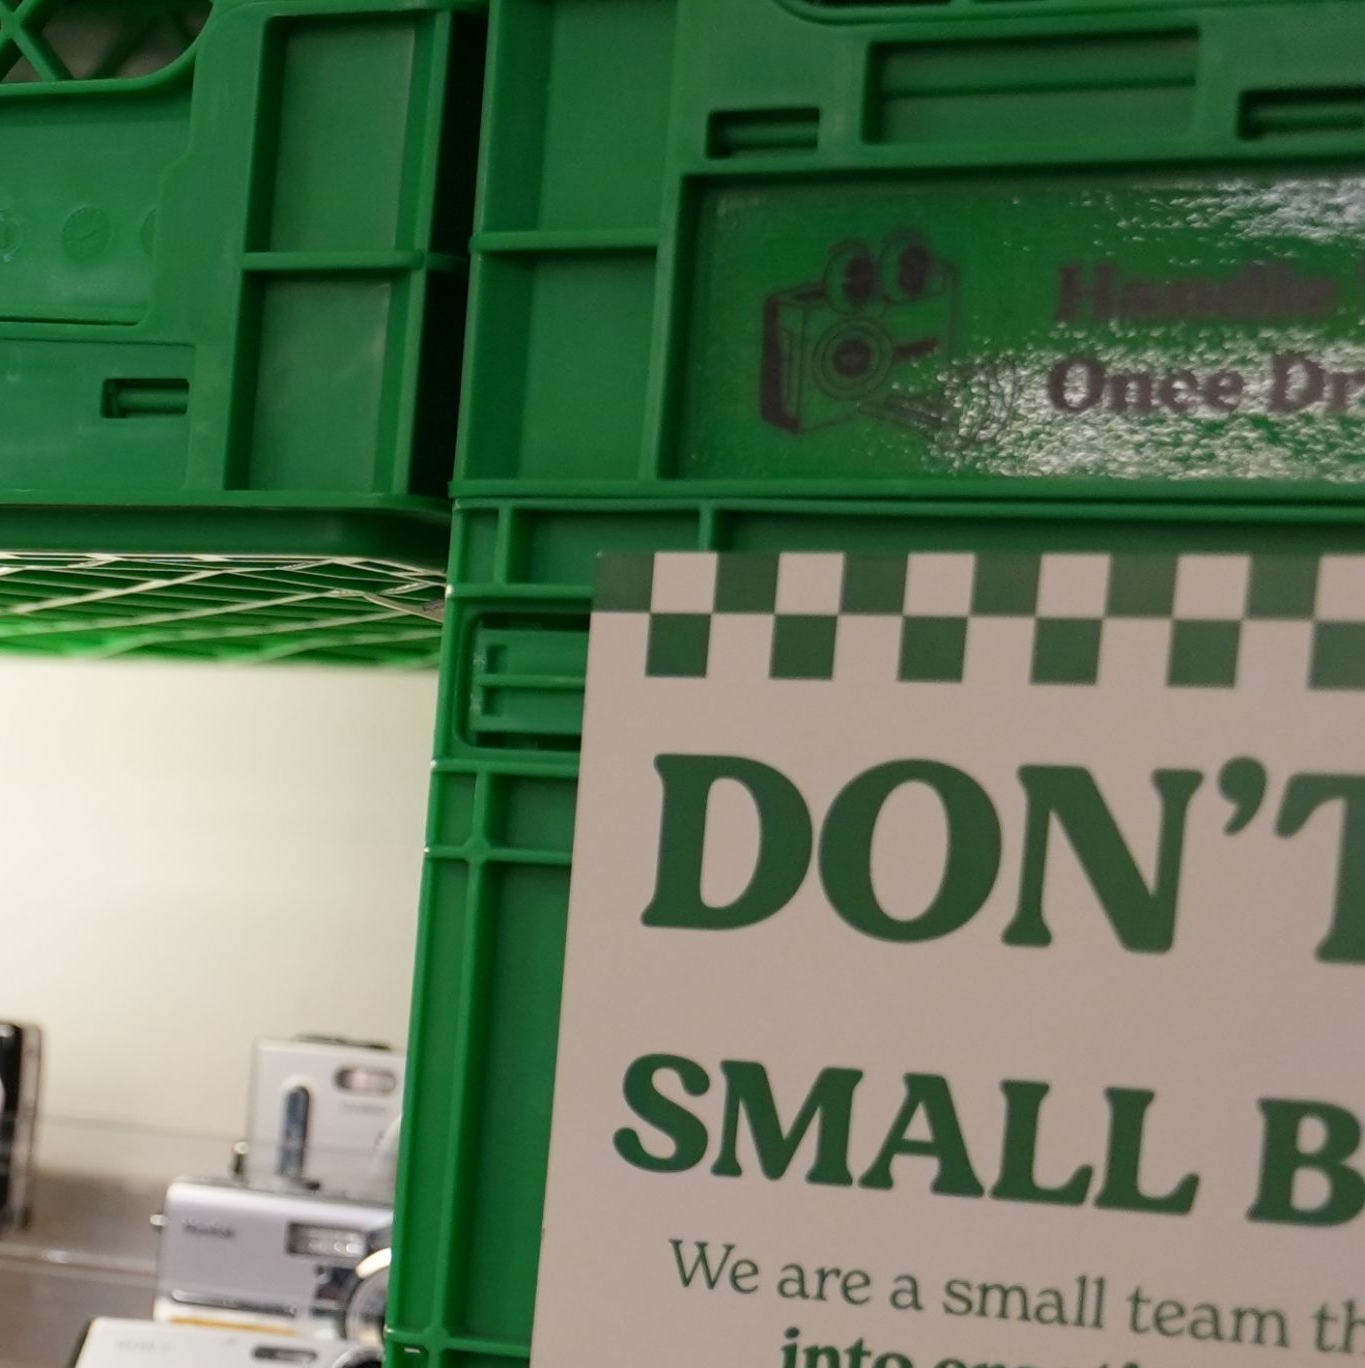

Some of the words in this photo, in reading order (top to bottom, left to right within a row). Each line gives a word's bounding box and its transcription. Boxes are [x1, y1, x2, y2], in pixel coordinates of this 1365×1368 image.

[1056, 264, 1340, 326] Handle
[1048, 356, 1245, 413] Once
[613, 1052, 1200, 1215] SMALL
[1245, 1095, 1365, 1227] B
[669, 1239, 760, 1294] We
[777, 1262, 871, 1305] are
[889, 1272, 924, 1311] a
[942, 1274, 1107, 1329] small
[1127, 1285, 1290, 1348] team
